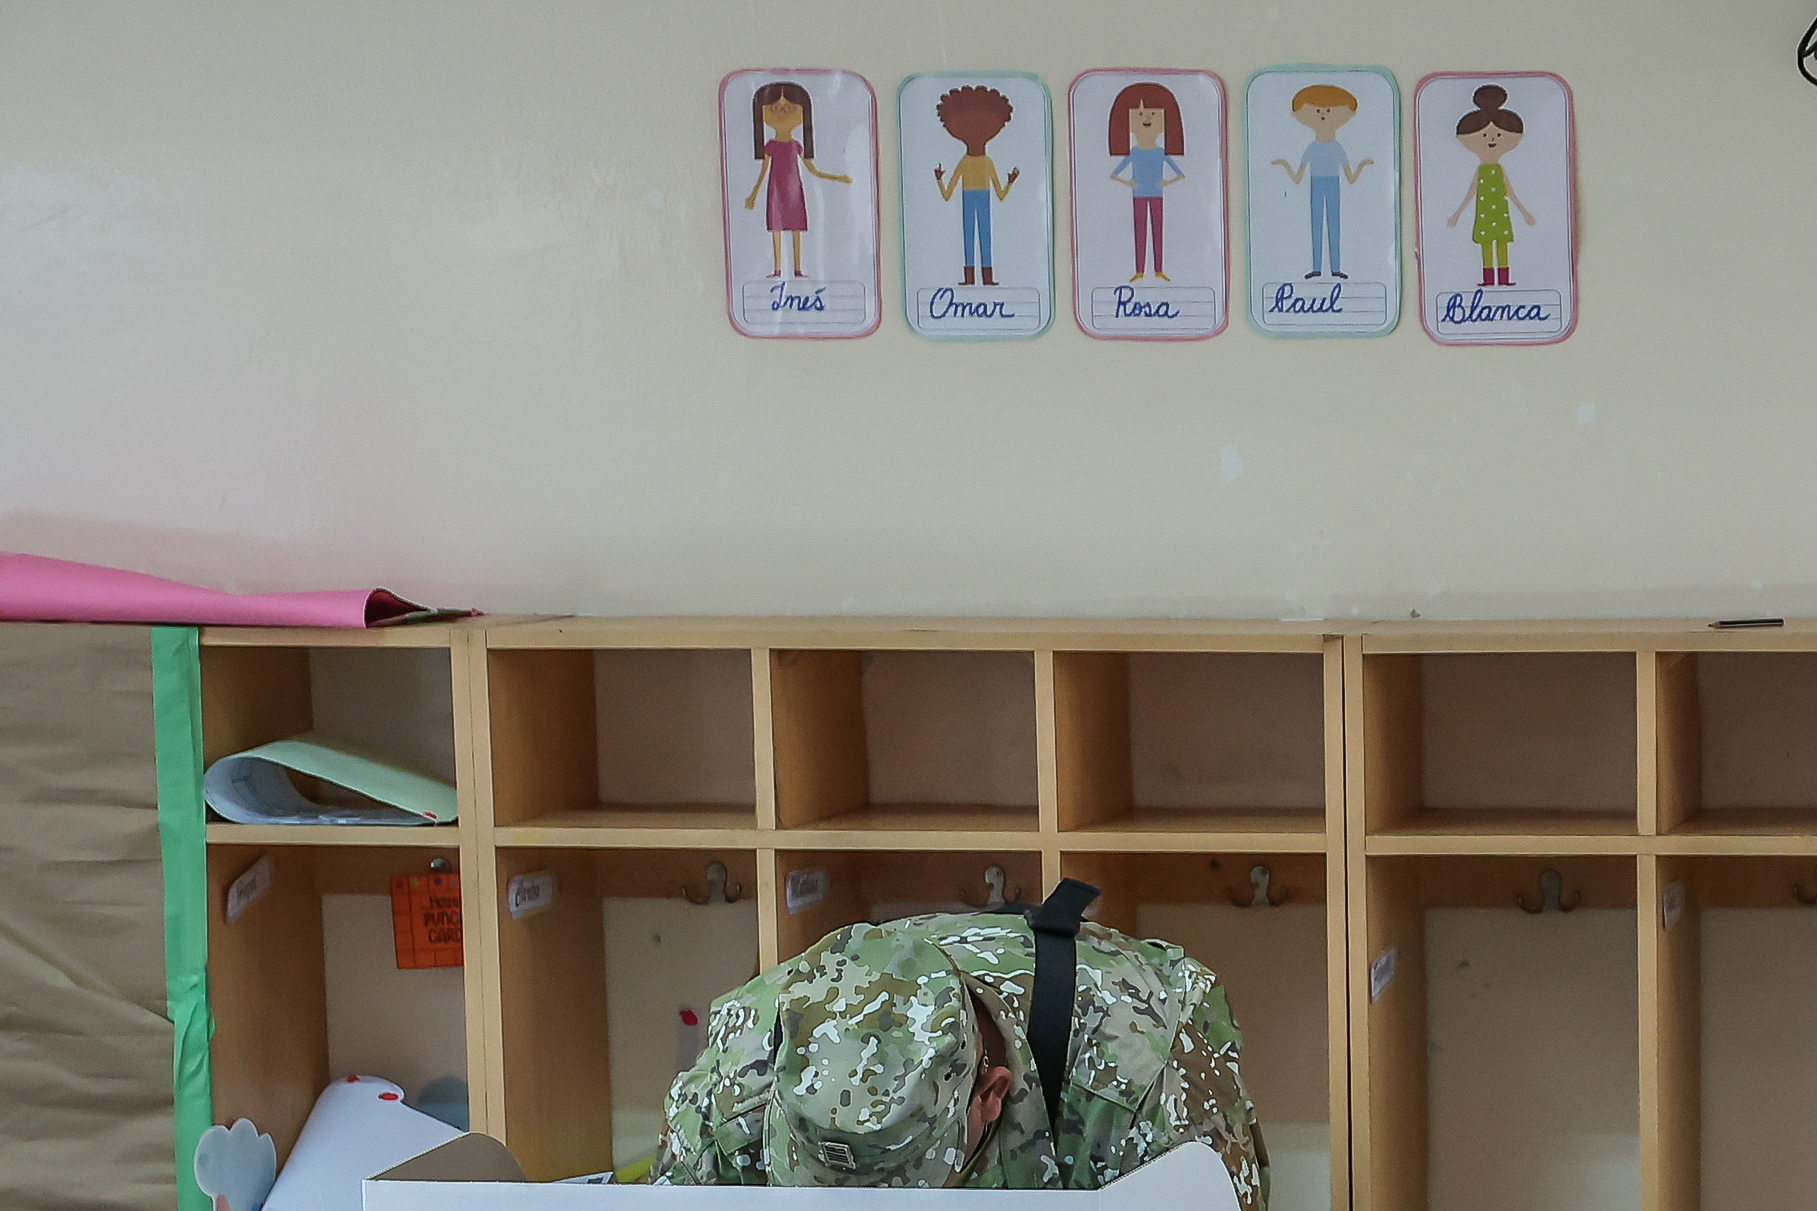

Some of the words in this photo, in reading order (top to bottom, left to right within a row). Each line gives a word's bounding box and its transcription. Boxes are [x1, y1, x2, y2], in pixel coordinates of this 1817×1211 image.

[929, 287, 1015, 319] Omar
[1114, 285, 1180, 319] Rosa
[1441, 289, 1550, 324] Blanca
